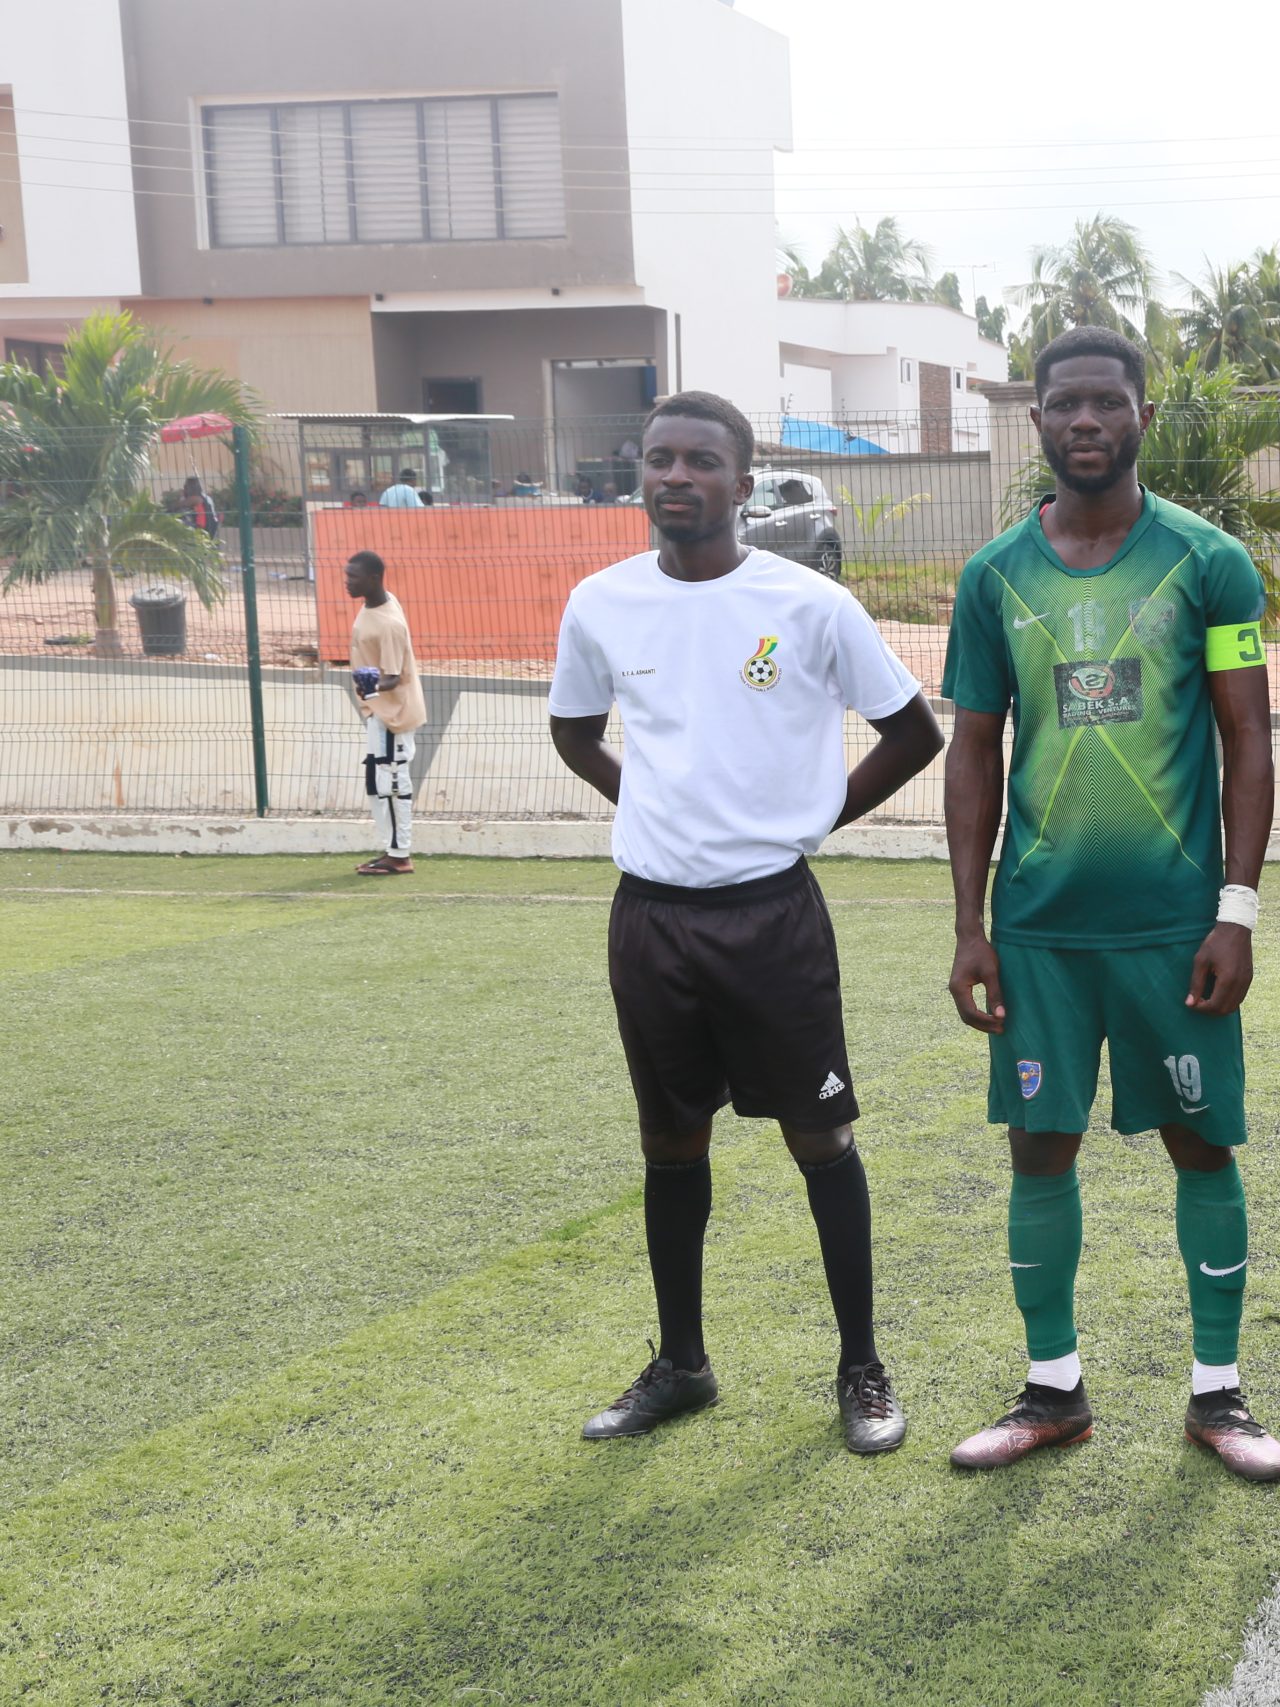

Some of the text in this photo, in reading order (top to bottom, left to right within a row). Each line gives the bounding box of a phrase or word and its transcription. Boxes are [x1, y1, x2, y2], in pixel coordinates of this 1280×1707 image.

[1237, 627, 1262, 662] C
[818, 1081, 846, 1100] adidas
[1163, 1054, 1202, 1102] 19
